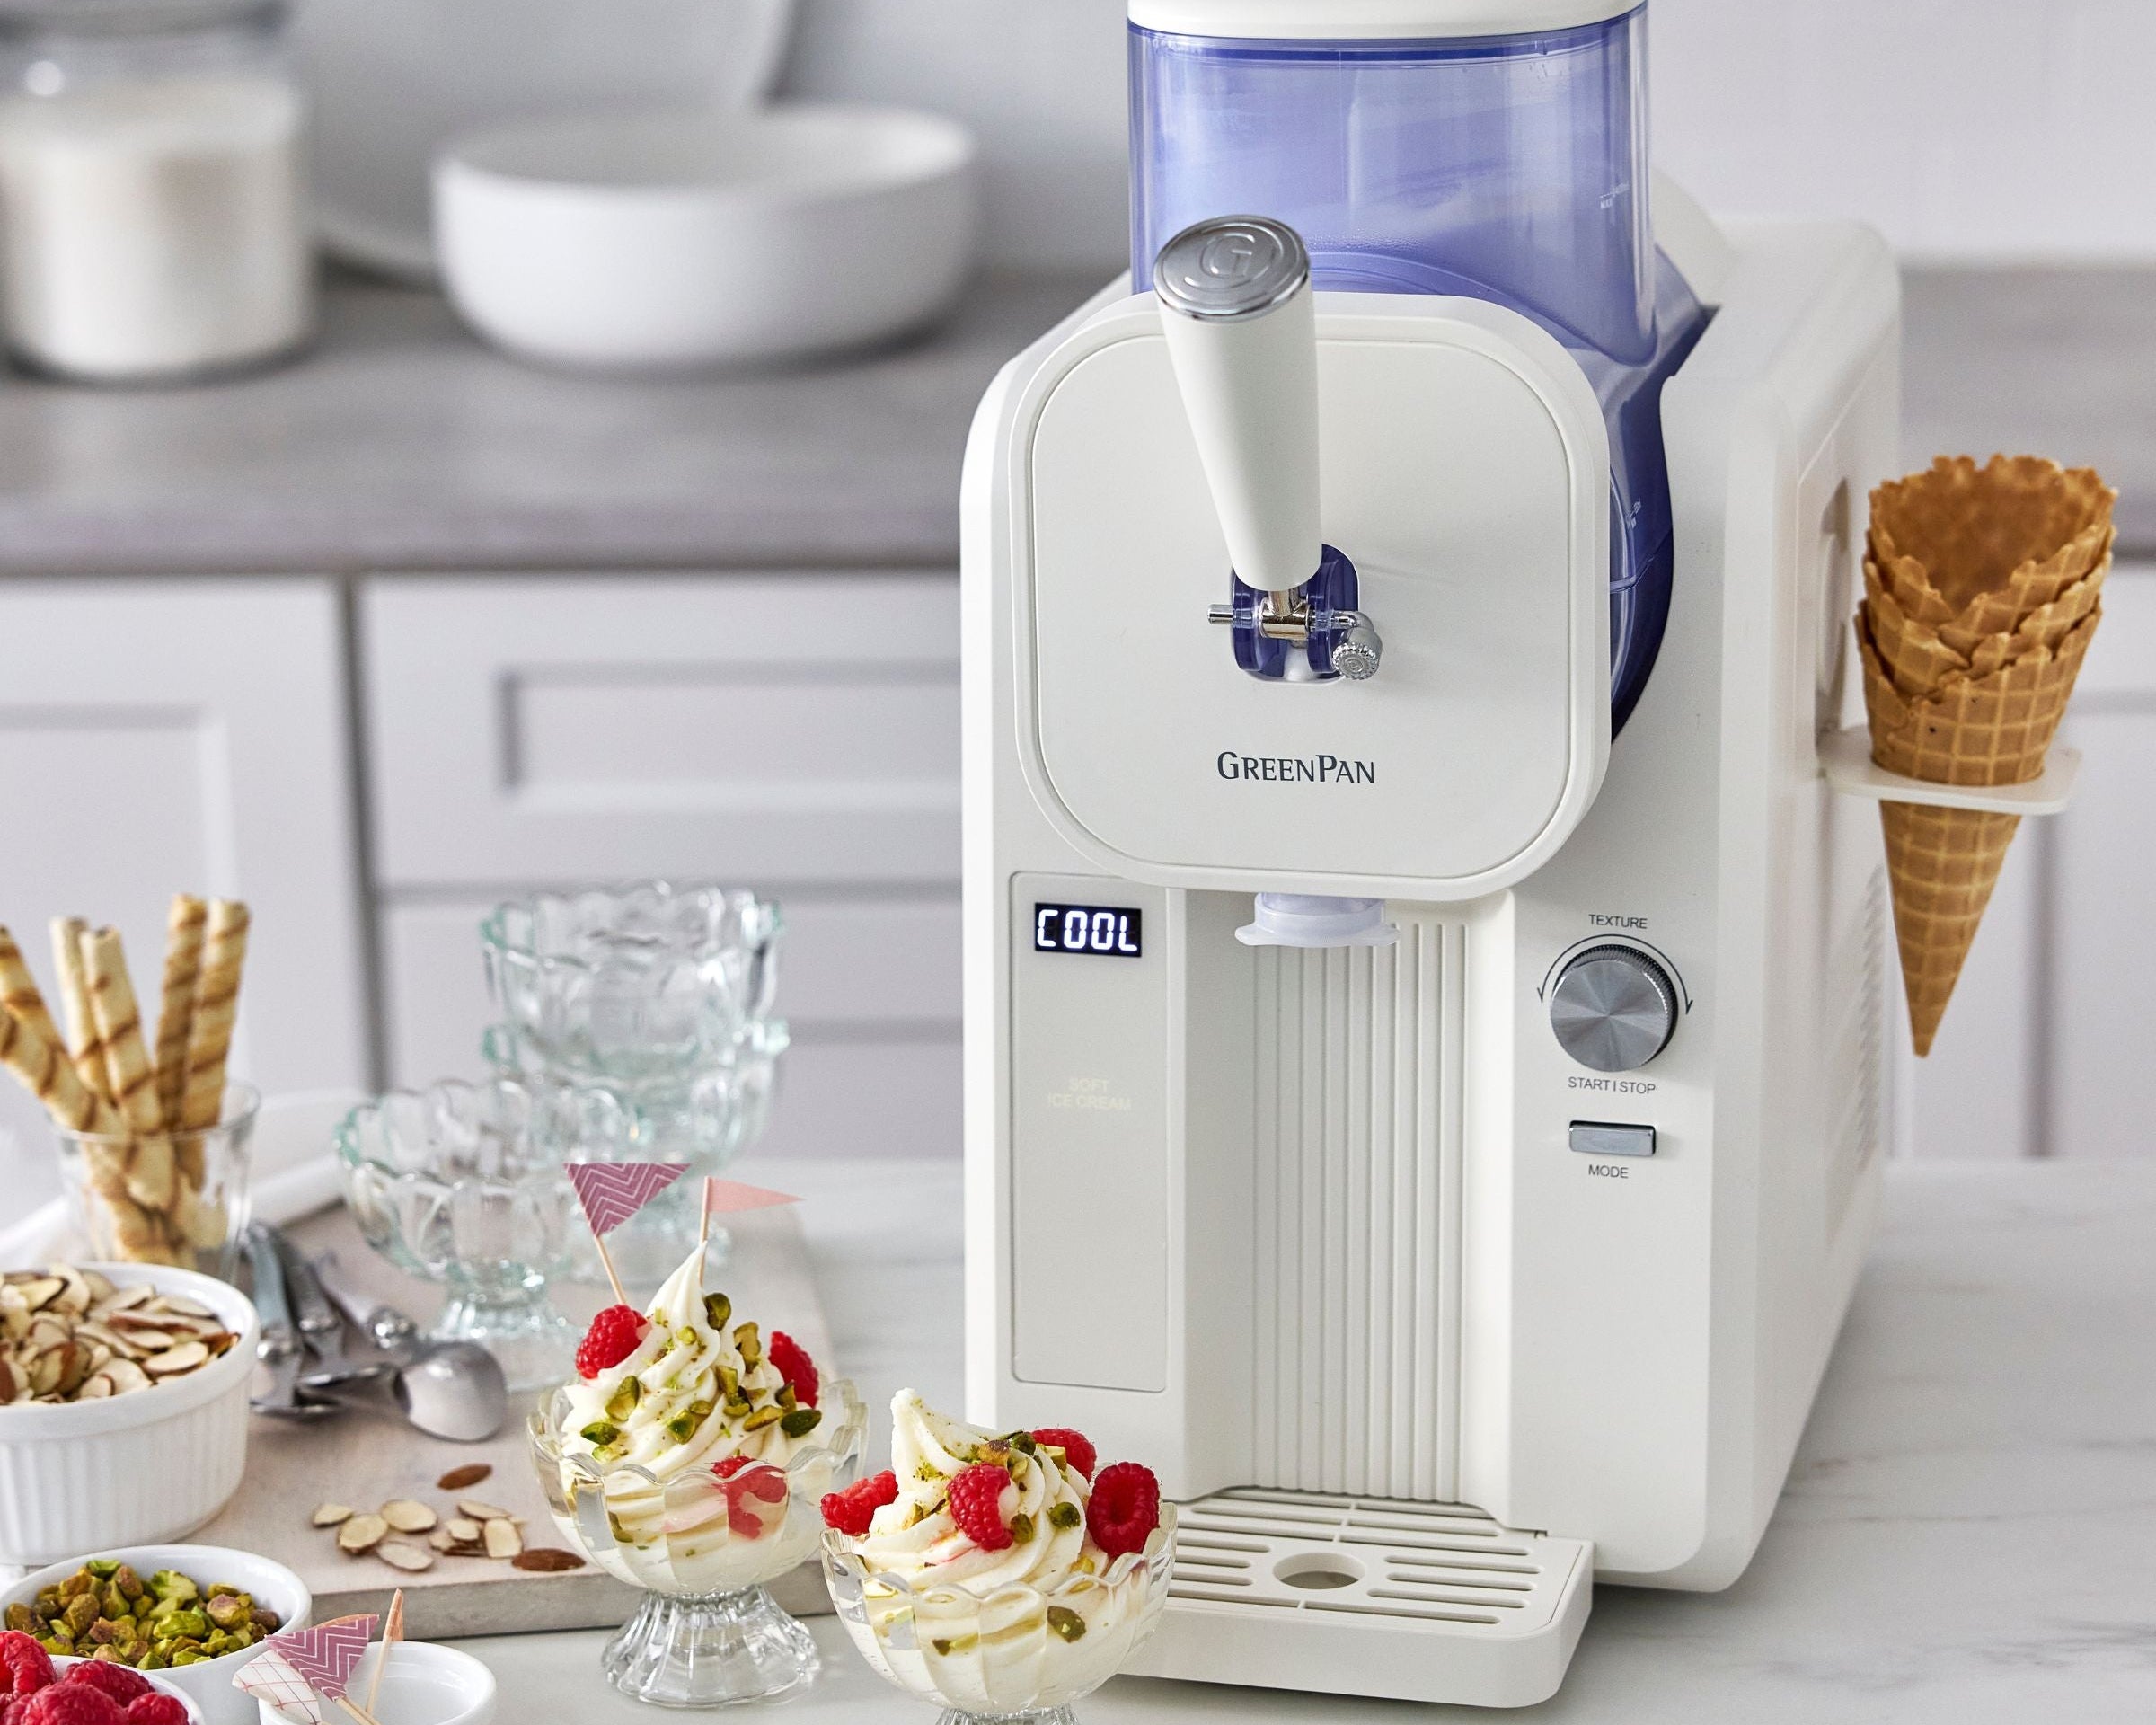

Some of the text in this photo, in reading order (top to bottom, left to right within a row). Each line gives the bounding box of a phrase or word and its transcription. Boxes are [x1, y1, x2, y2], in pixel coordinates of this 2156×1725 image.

[1217, 751, 1374, 783] GREENPAN
[1037, 909, 1138, 951] COOL
[1588, 914, 1648, 929] TEXTURE
[1069, 1077, 1109, 1092] SOFT
[1568, 1076, 1610, 1091] START
[1619, 1081, 1656, 1094] STOP
[1047, 1092, 1132, 1110] ICE CREAM
[1588, 1164, 1629, 1179] MODE
